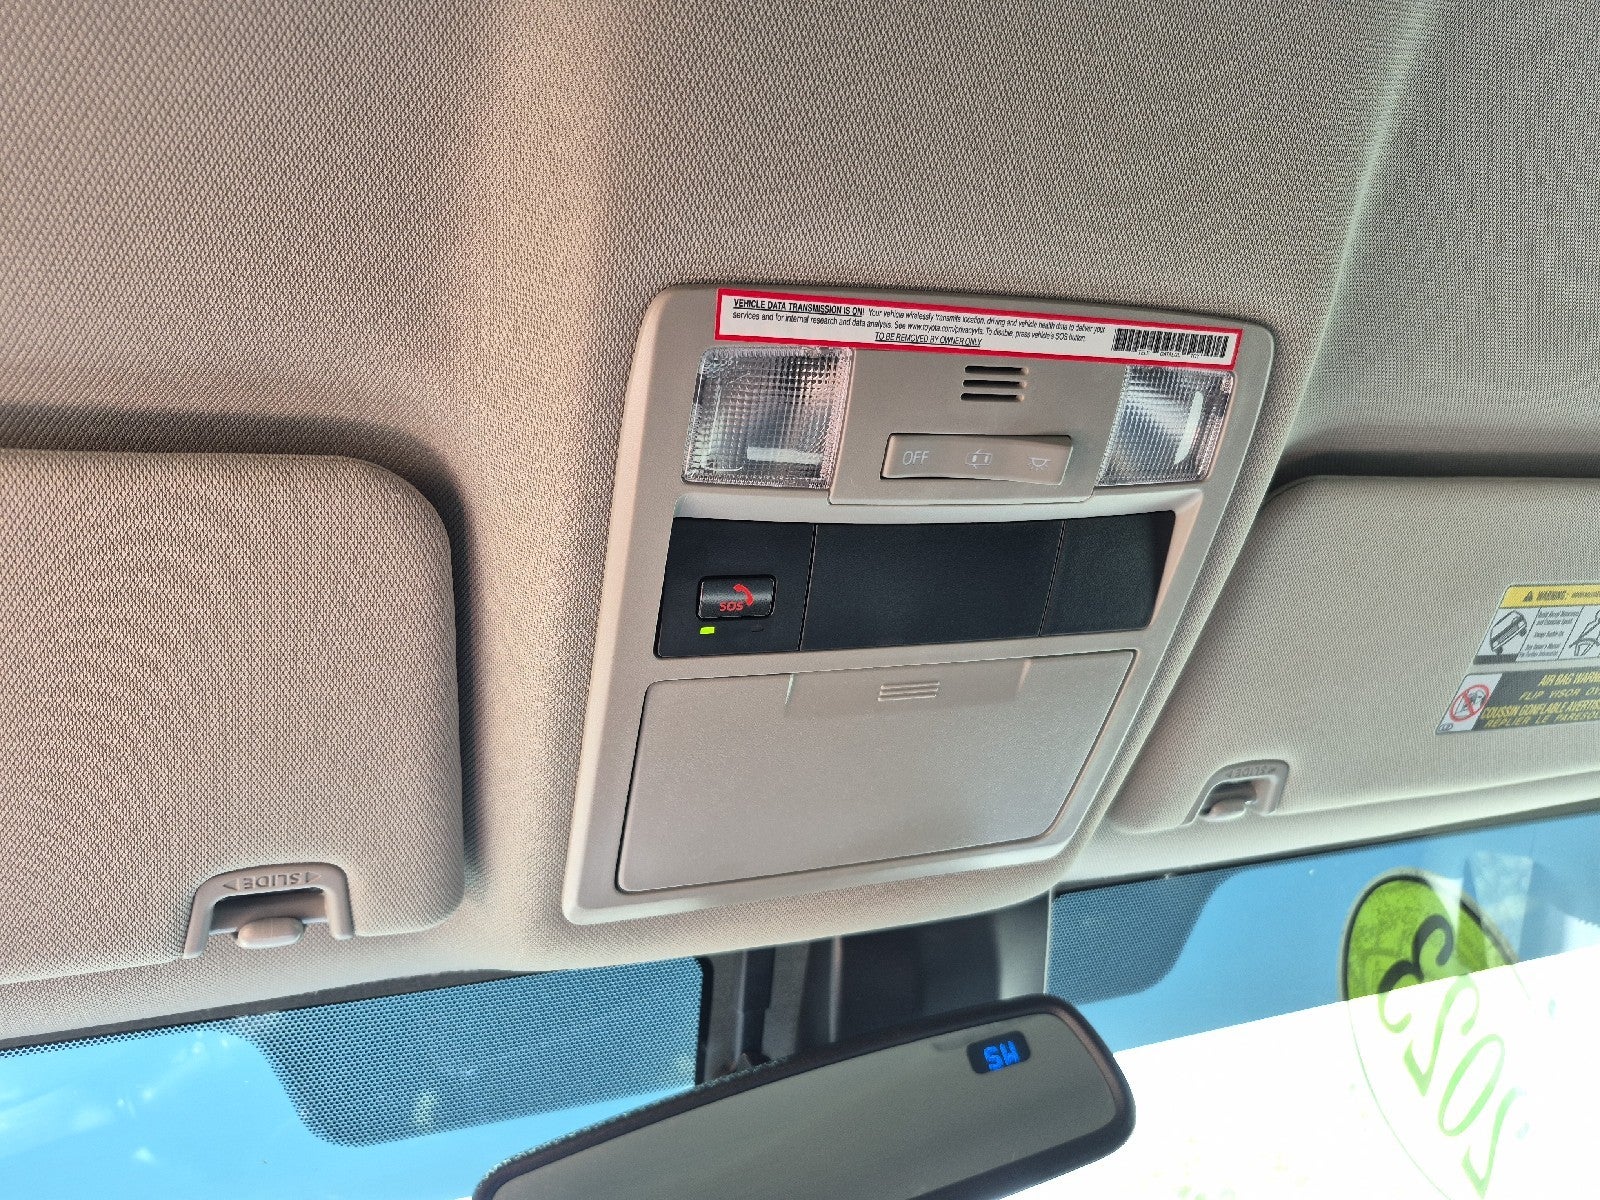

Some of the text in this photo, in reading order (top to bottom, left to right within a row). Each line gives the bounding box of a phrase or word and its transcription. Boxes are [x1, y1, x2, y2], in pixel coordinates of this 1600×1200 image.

[733, 298, 766, 309] VEHICLE
[767, 300, 786, 311] DATA
[788, 302, 842, 315] TRANSMISSION
[843, 306, 851, 315] IS
[852, 306, 865, 316] ON!
[868, 308, 882, 317] Your
[884, 309, 905, 319] vehicle
[905, 310, 934, 322] wirelessly
[935, 313, 961, 323] transmits
[986, 317, 1006, 328] driving
[1006, 318, 1018, 327] and
[1018, 319, 1038, 329] vehicle
[1038, 320, 1055, 330] health
[1055, 322, 1068, 331] data
[1068, 323, 1075, 332] to
[1075, 324, 1092, 333] deliver
[1092, 326, 1106, 335] your
[732, 310, 760, 320] services
[761, 312, 774, 321] and
[775, 312, 784, 322] for
[785, 313, 810, 324] internal
[810, 316, 838, 325] research
[839, 317, 850, 326] and
[851, 318, 866, 327] data
[866, 319, 893, 330] analysis.
[894, 320, 906, 330] See
[985, 326, 993, 335] To
[1014, 330, 1031, 339] press
[1031, 331, 1055, 340] vehicle's
[1055, 332, 1068, 341] SOS
[874, 331, 983, 346] TO BE REMOVED BY OWNER ONLY
[902, 450, 930, 466] OFF
[719, 601, 744, 612] SOS
[1538, 674, 1556, 686] AIR
[1554, 673, 1575, 685] BAG
[1519, 690, 1545, 701] FLIP
[1549, 688, 1580, 698] VISOR
[1534, 714, 1550, 724] LE
[243, 872, 301, 890] SLIDE
[983, 1040, 1021, 1072] SW
